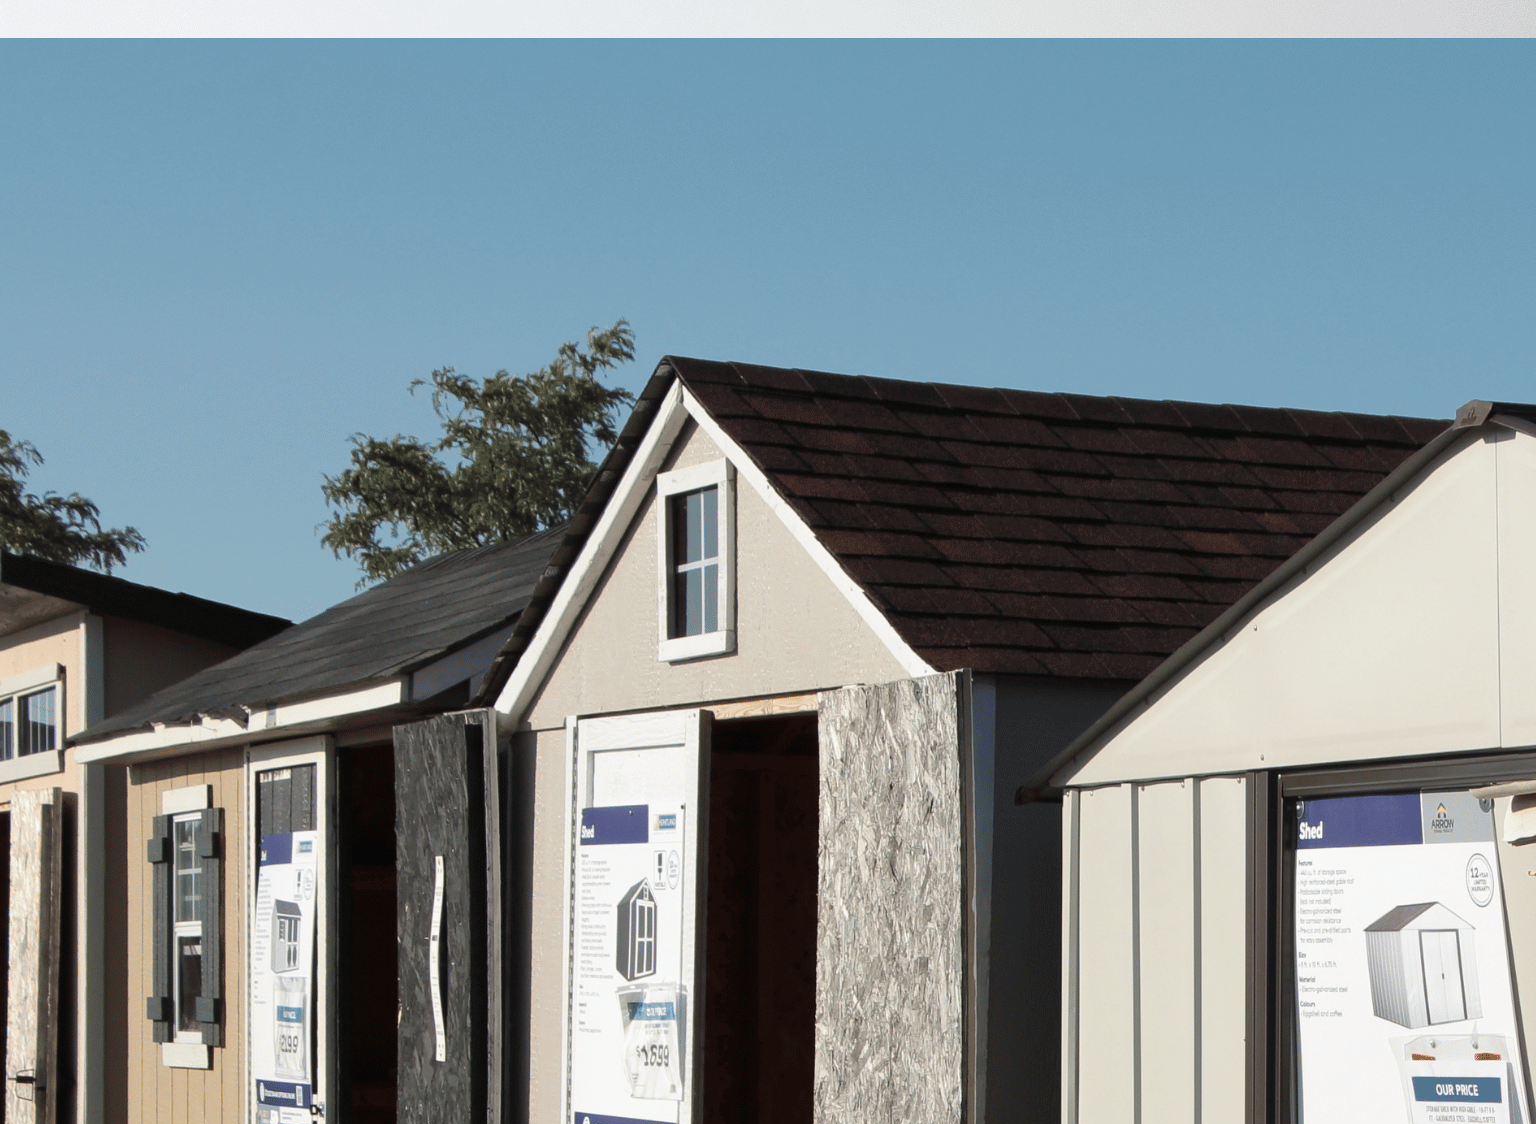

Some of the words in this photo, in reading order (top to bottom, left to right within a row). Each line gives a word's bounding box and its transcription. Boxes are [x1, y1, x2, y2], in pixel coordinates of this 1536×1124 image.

[1300, 821, 1323, 839] Shed
[1431, 819, 1454, 829] ARROW
[1436, 1084, 1454, 1095] OUR
[1456, 1084, 1479, 1096] PRICE
